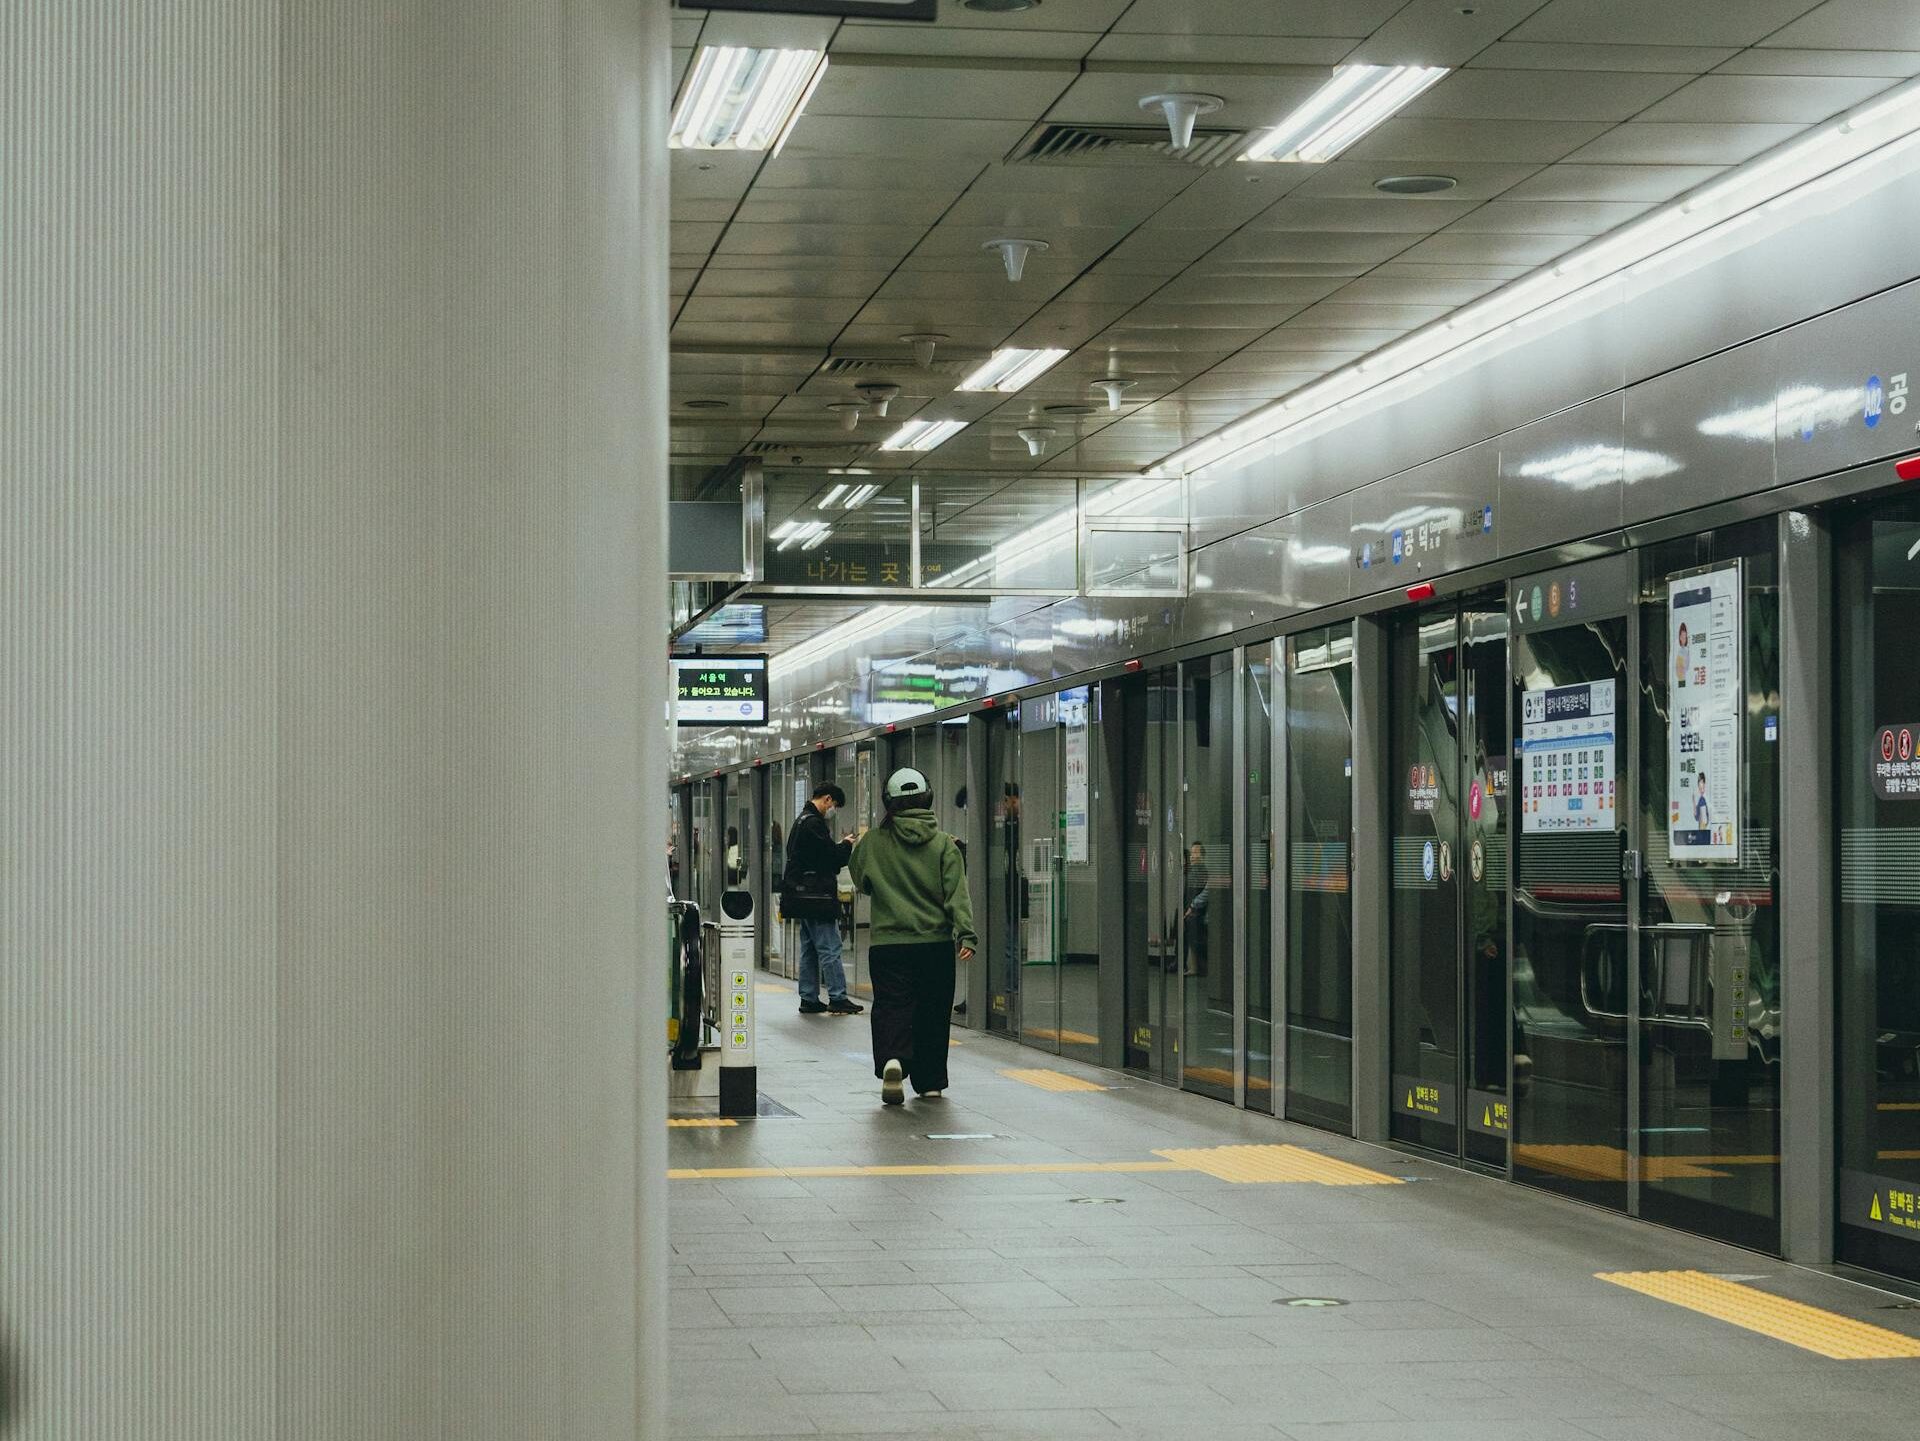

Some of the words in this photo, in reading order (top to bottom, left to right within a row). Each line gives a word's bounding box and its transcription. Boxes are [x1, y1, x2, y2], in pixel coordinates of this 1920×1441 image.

[1888, 373, 1908, 414] 공
[808, 561, 868, 582] 나가는
[880, 562, 900, 582] 곳
[1570, 581, 1576, 600] 5
[699, 672, 726, 682] 서울역
[691, 687, 721, 697] 들어오고
[723, 687, 756, 697] 있습니다.
